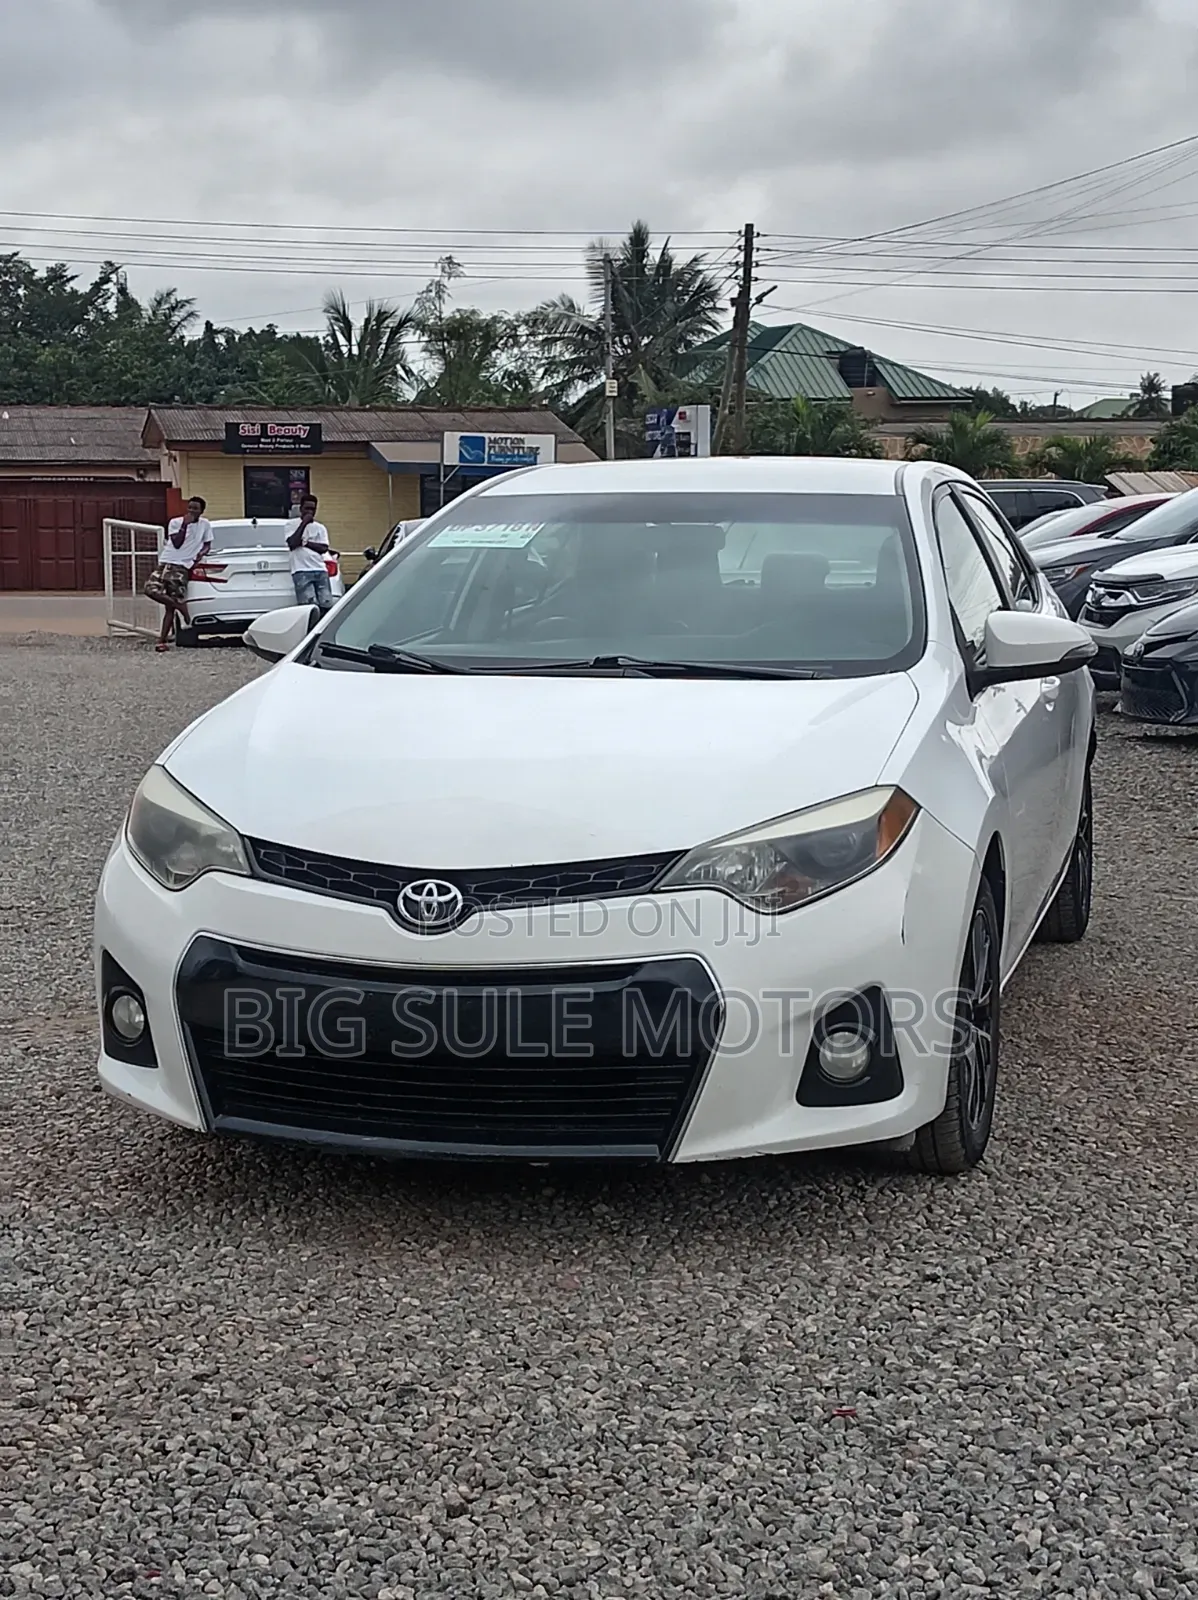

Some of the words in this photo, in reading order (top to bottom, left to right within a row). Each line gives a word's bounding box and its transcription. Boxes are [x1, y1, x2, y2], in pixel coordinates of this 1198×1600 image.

[239, 424, 261, 436] Sisi
[267, 424, 310, 438] Beauty
[487, 436, 526, 445] MOTION
[487, 445, 541, 456] FURNITURE
